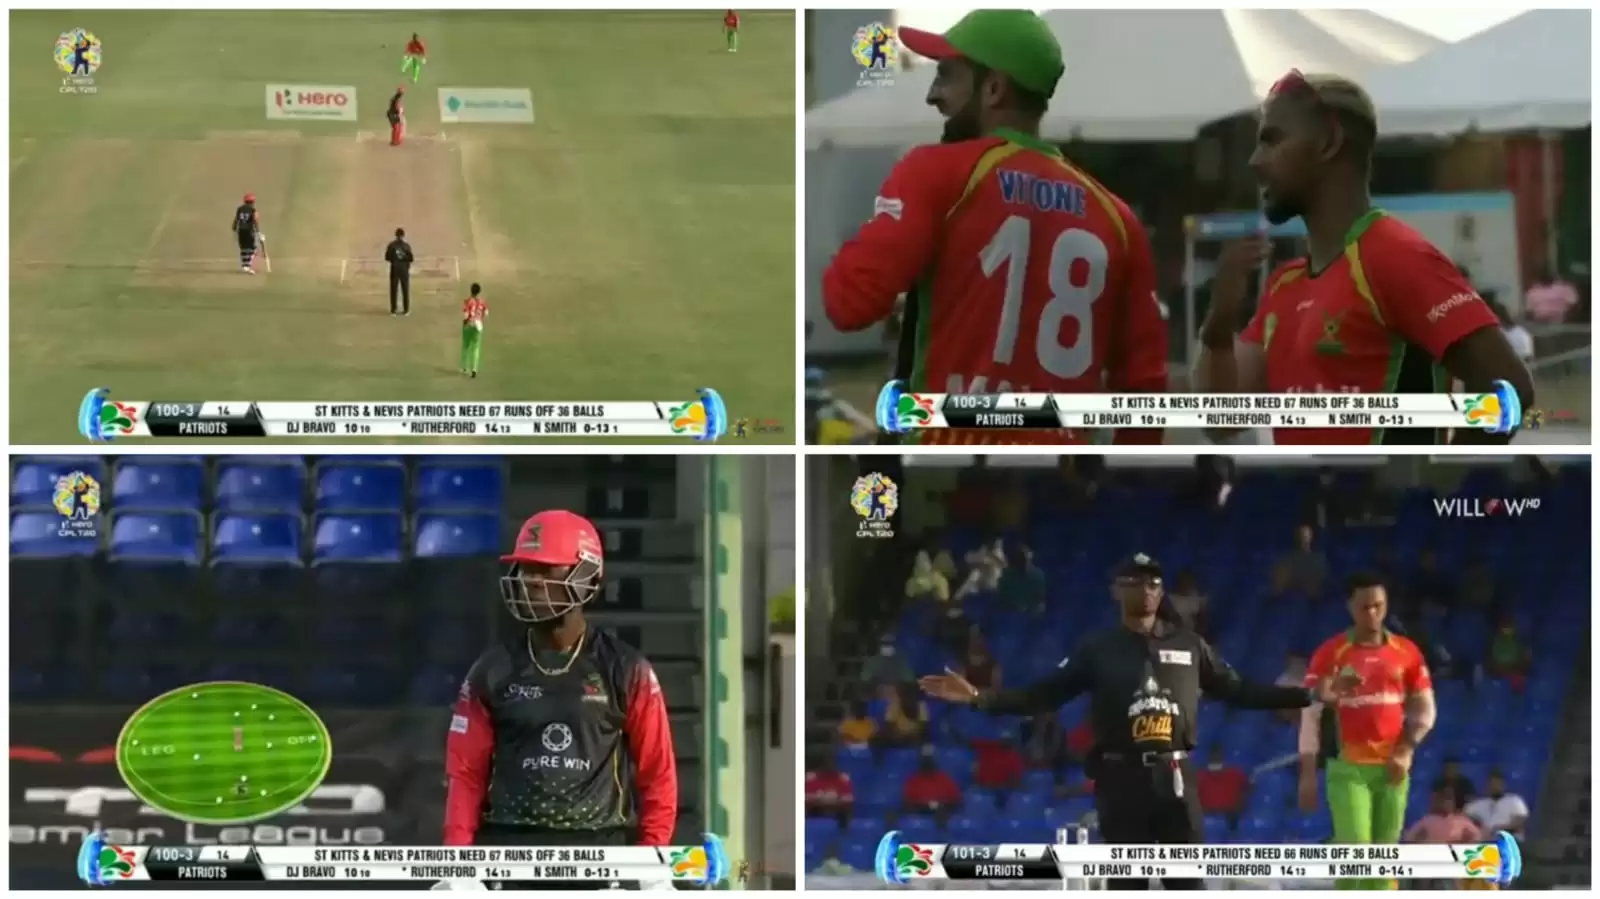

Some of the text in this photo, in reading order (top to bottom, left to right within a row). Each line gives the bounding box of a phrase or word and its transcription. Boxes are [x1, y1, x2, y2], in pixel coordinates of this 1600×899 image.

[978, 215, 1109, 379] 18
[1131, 713, 1173, 739] Chill
[563, 757, 591, 770] WIN
